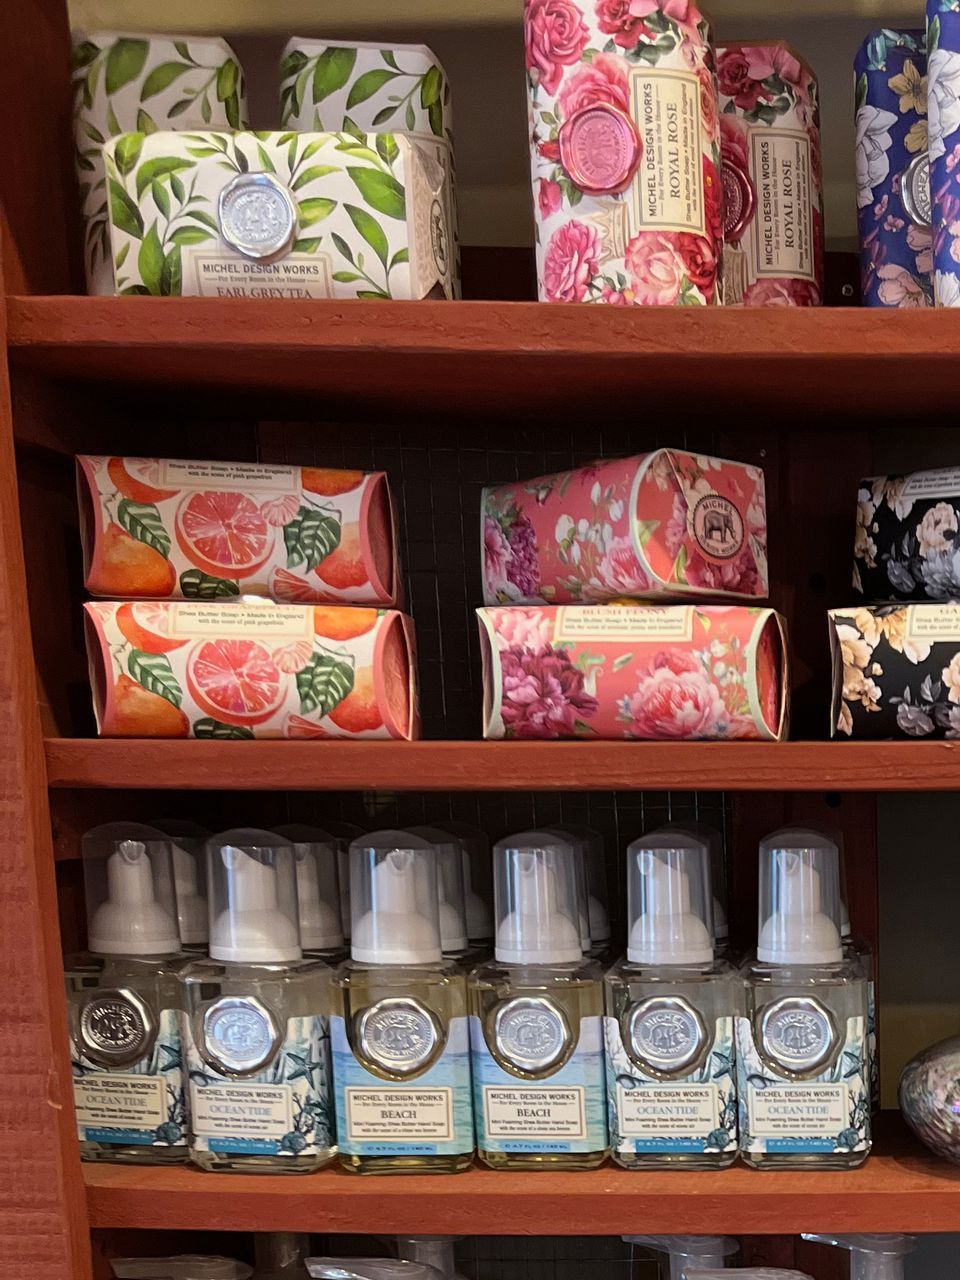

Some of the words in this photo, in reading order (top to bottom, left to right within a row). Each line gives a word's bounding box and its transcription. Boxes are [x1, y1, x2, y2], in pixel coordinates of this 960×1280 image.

[644, 83, 653, 124] WORKS
[667, 103, 678, 143] ROSE
[646, 128, 655, 170] DESIGN
[669, 148, 680, 198] ROYAL
[782, 160, 792, 197] ROSE
[648, 175, 657, 216] MICHEL
[784, 202, 794, 248] ROYAL
[203, 264, 240, 274] MICHEL
[243, 264, 280, 274] DESIGN
[282, 265, 319, 275] WORKS
[517, 1109, 551, 1117] BEACH
[637, 1106, 673, 1115] OCEAN
[675, 1106, 698, 1115] TIDE
[768, 1106, 804, 1115] OCEAN
[806, 1106, 829, 1115] TIDE
